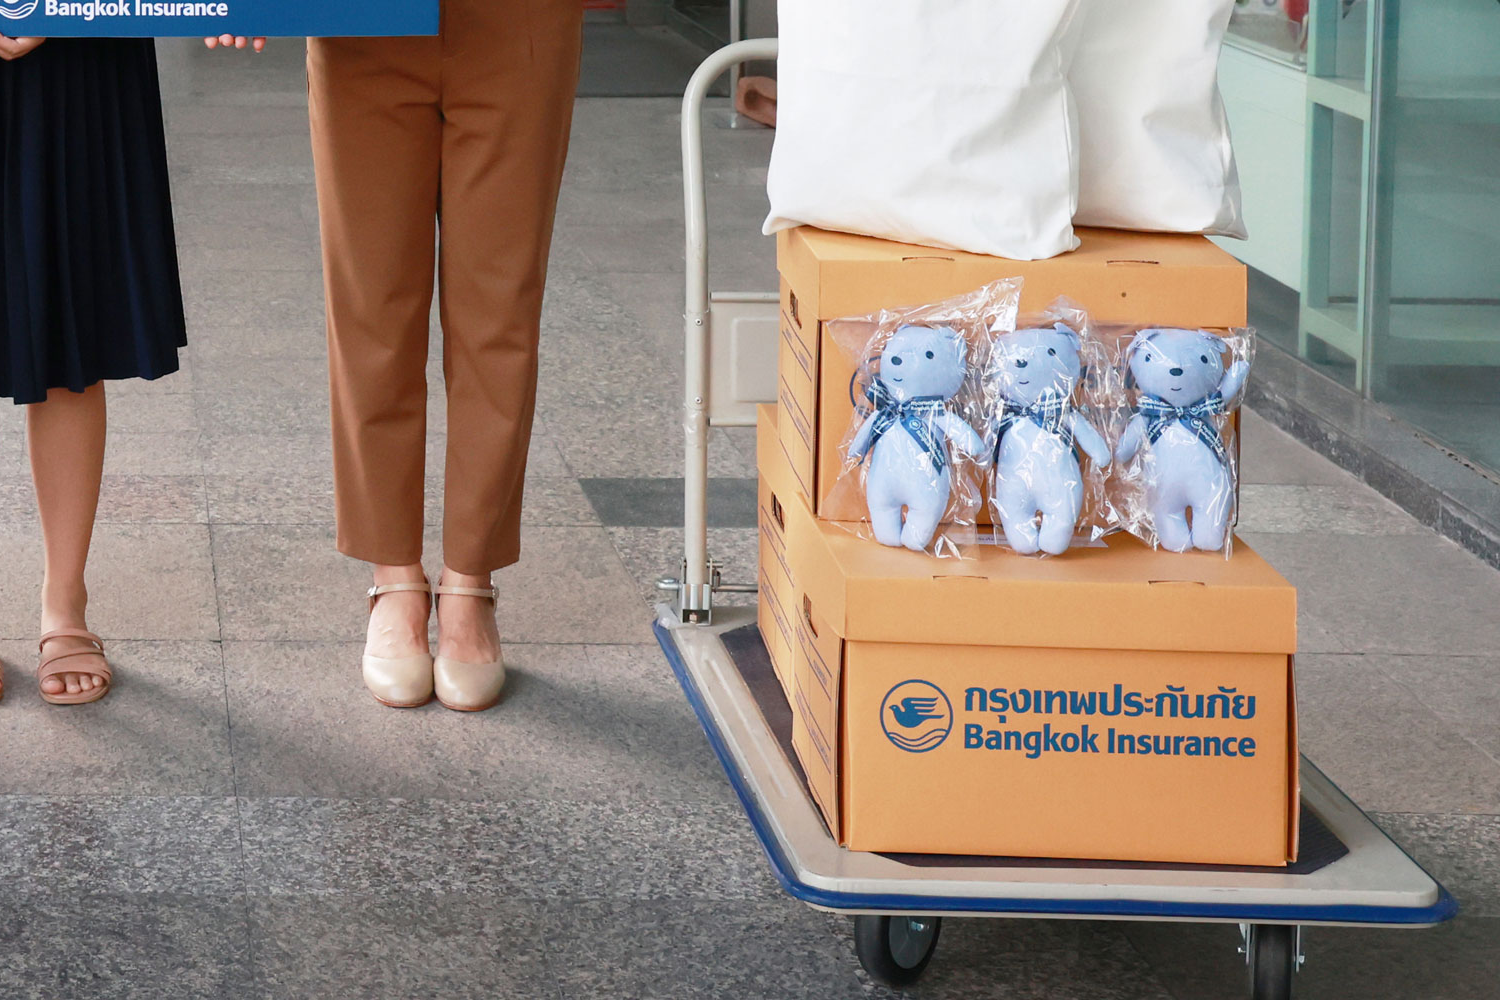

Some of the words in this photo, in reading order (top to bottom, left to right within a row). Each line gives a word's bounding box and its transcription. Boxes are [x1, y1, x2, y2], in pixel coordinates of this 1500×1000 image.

[135, 0, 228, 16] Insurance
[964, 683, 1256, 724] กรุงเทพประกันภัย
[964, 723, 1100, 760] Bangkok
[1107, 727, 1256, 758] Insurance
